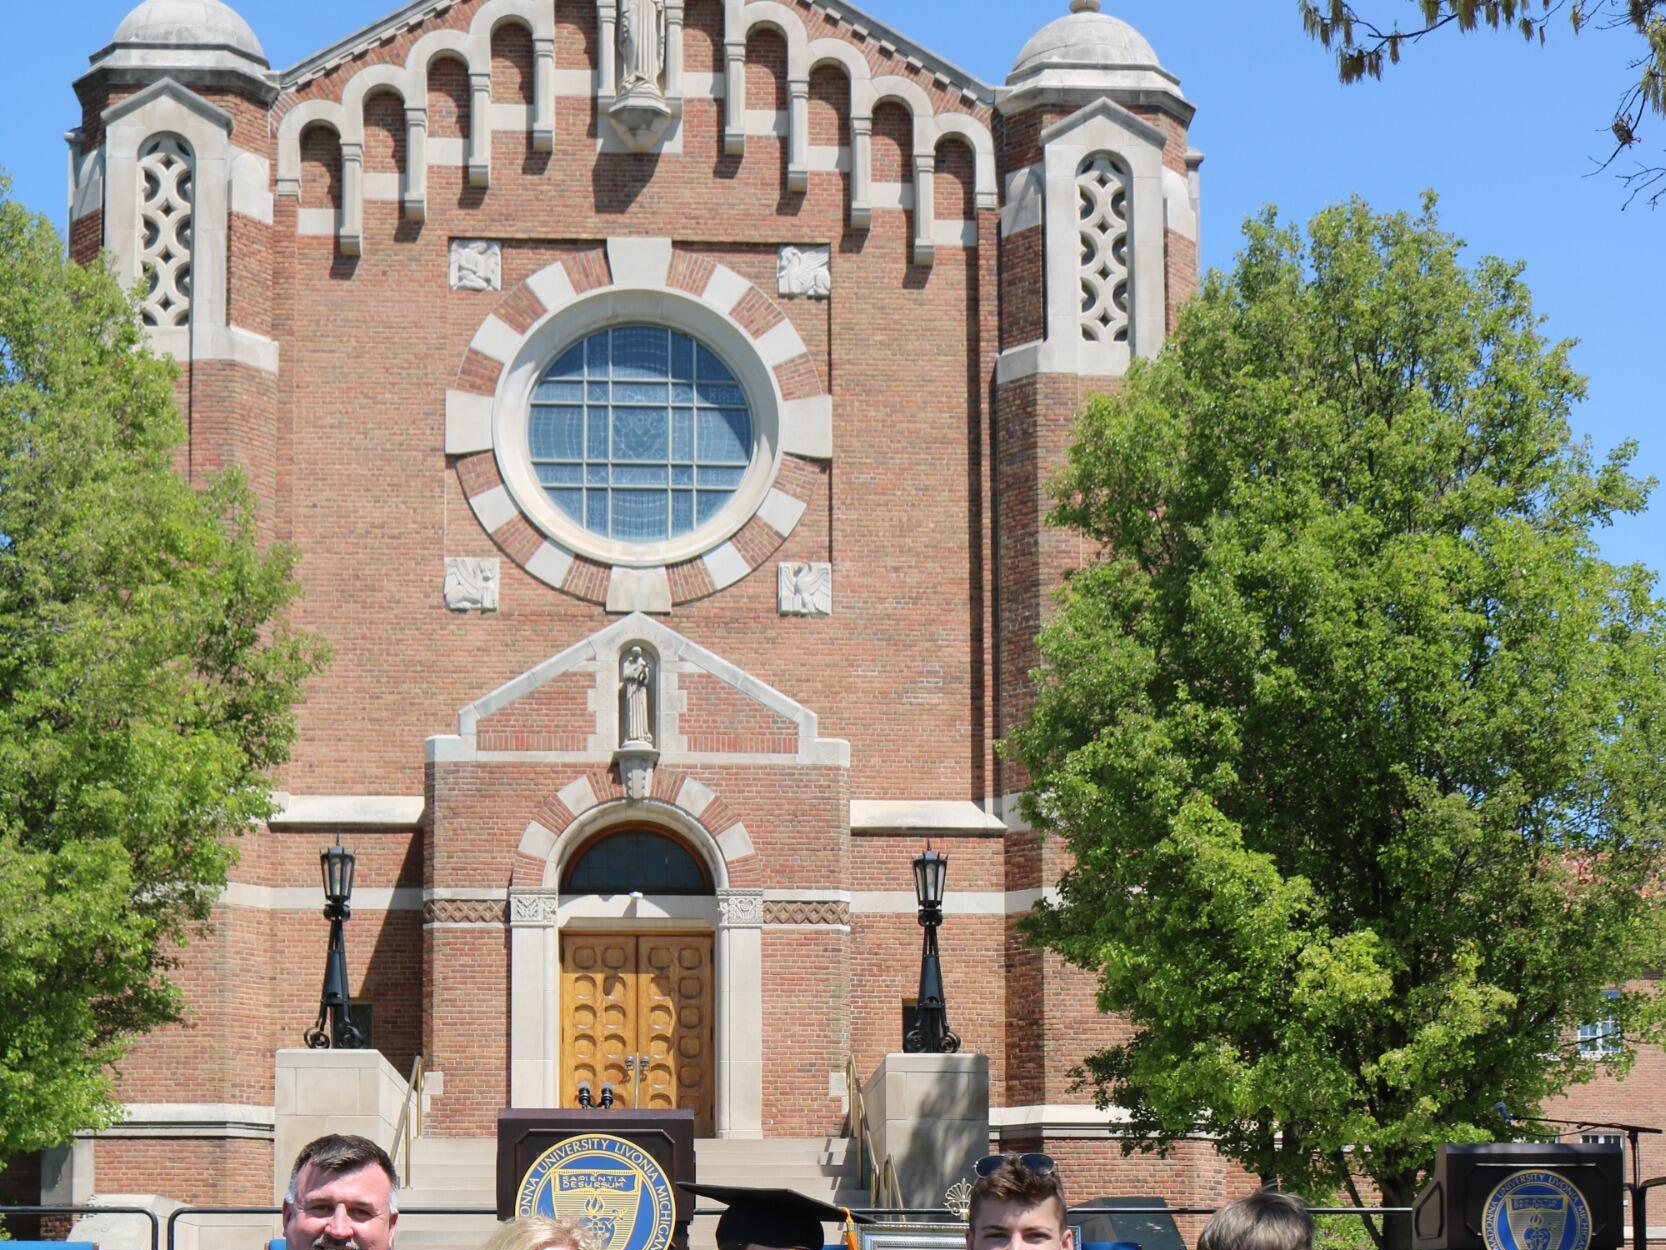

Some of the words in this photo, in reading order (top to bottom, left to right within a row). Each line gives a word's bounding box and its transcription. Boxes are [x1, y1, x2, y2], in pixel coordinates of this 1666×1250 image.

[520, 1178, 540, 1217] ONNA
[539, 1139, 610, 1174] UNIVERSITY
[614, 1143, 659, 1183] LIVONIA
[562, 1175, 627, 1183] SAPIENTIA
[1496, 1173, 1545, 1198] UNIVERSITY
[1548, 1176, 1580, 1203] LIVONIA
